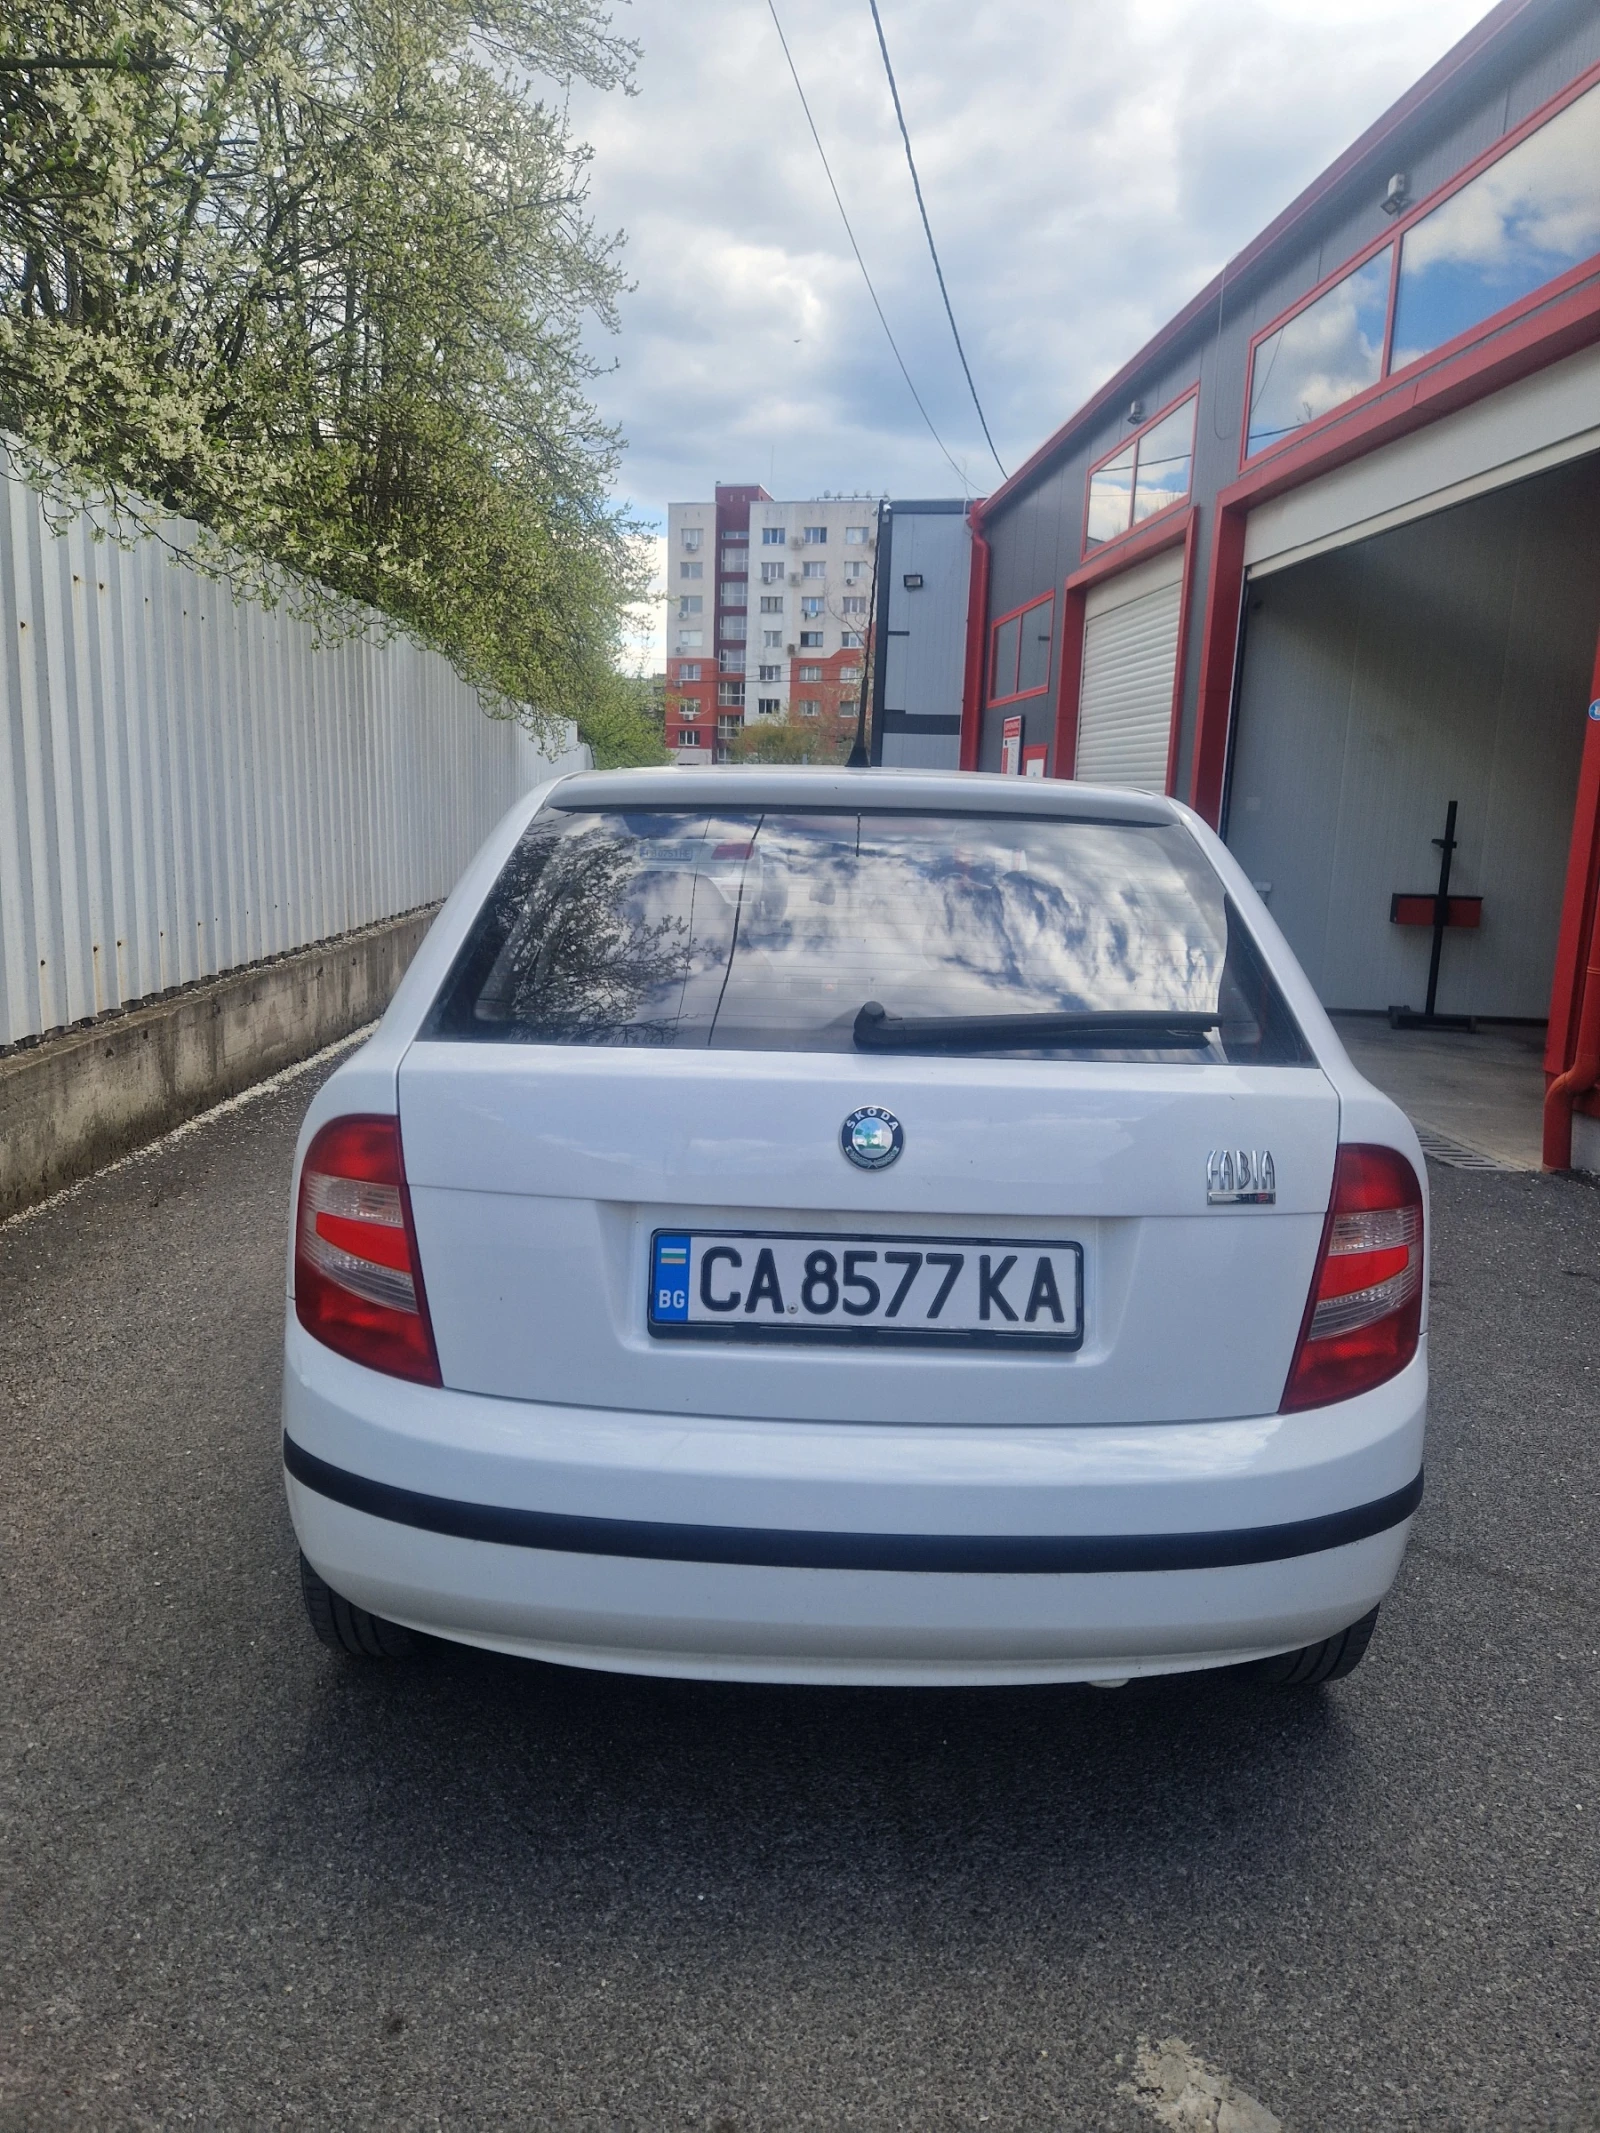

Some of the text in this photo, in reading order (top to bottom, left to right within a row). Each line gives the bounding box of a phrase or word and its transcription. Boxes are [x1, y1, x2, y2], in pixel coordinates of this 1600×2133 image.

[846, 1108, 899, 1131] SKODA
[1206, 1150, 1276, 1190] FABIA
[658, 1289, 685, 1309] BG
[700, 1246, 1066, 1323] CA 8577 KA
